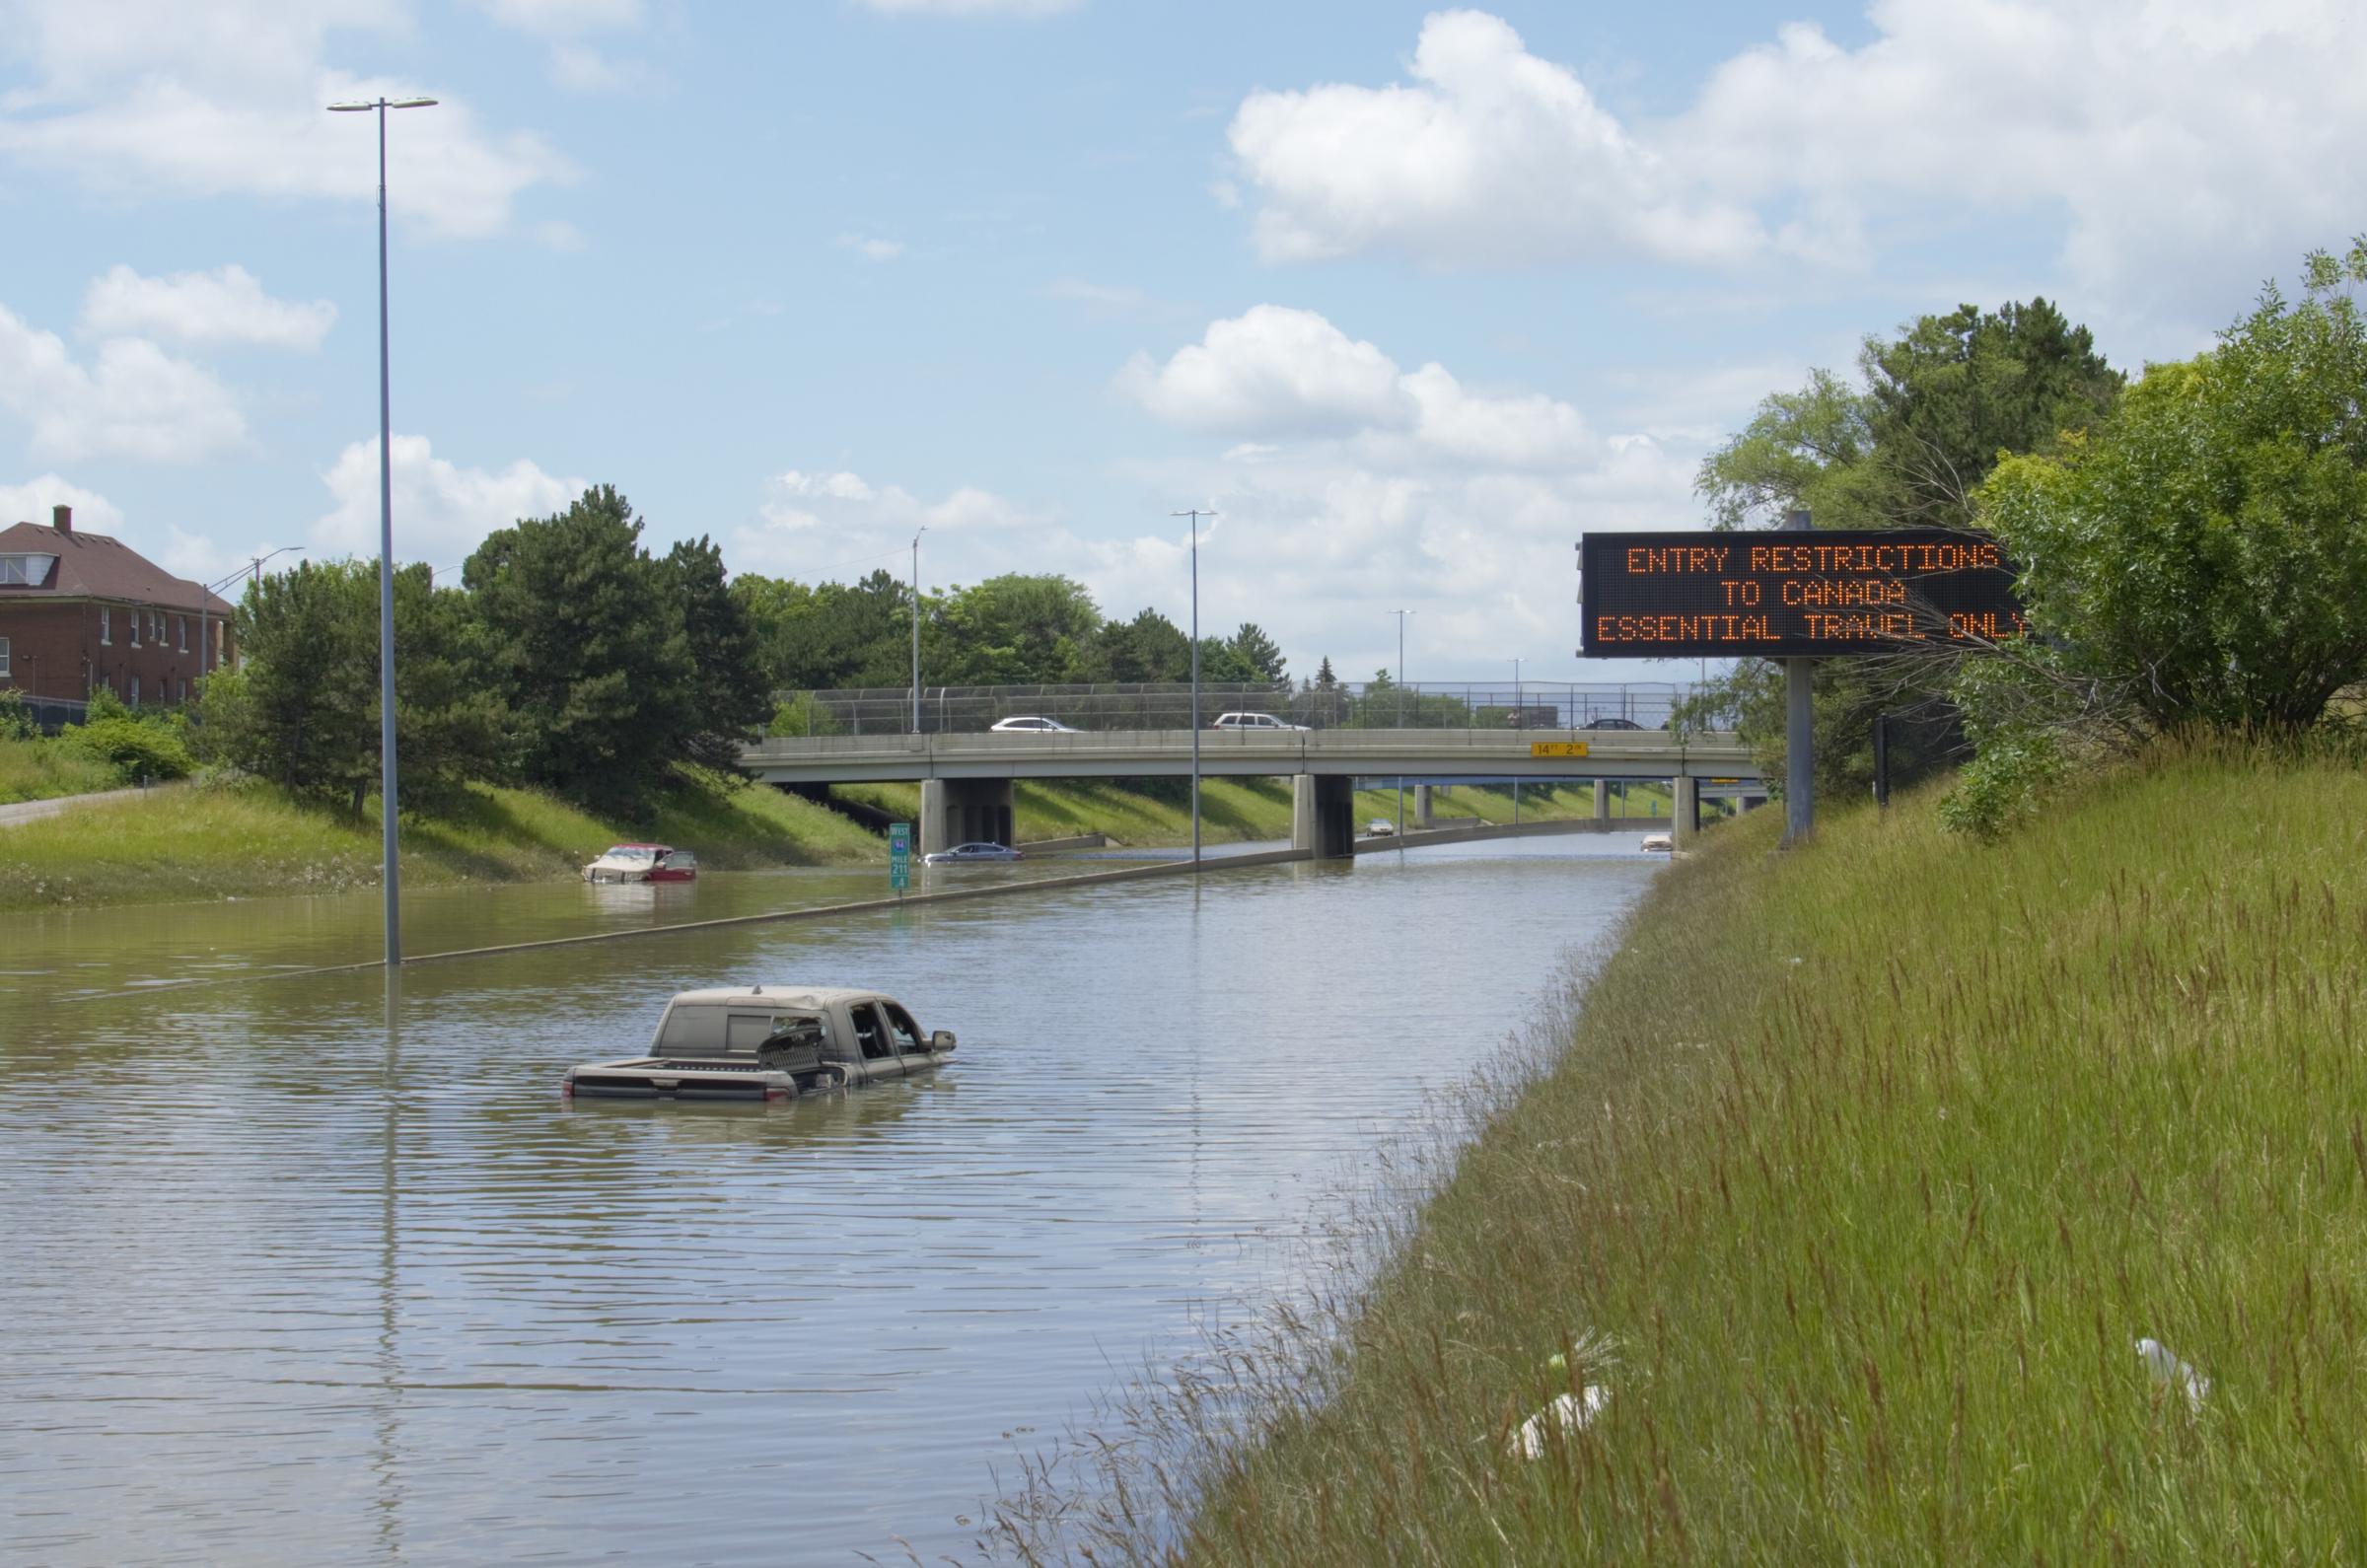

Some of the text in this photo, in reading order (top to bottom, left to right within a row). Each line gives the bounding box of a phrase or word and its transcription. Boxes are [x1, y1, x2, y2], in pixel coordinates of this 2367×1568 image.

[1627, 544, 1999, 573] ENTRY RESTRICTIONS
[1721, 580, 1905, 606] TO CANADA
[1597, 612, 2028, 641] ESSENTIAL TRAVEL ONLY
[892, 855, 908, 864] MILE
[893, 864, 907, 874] 211
